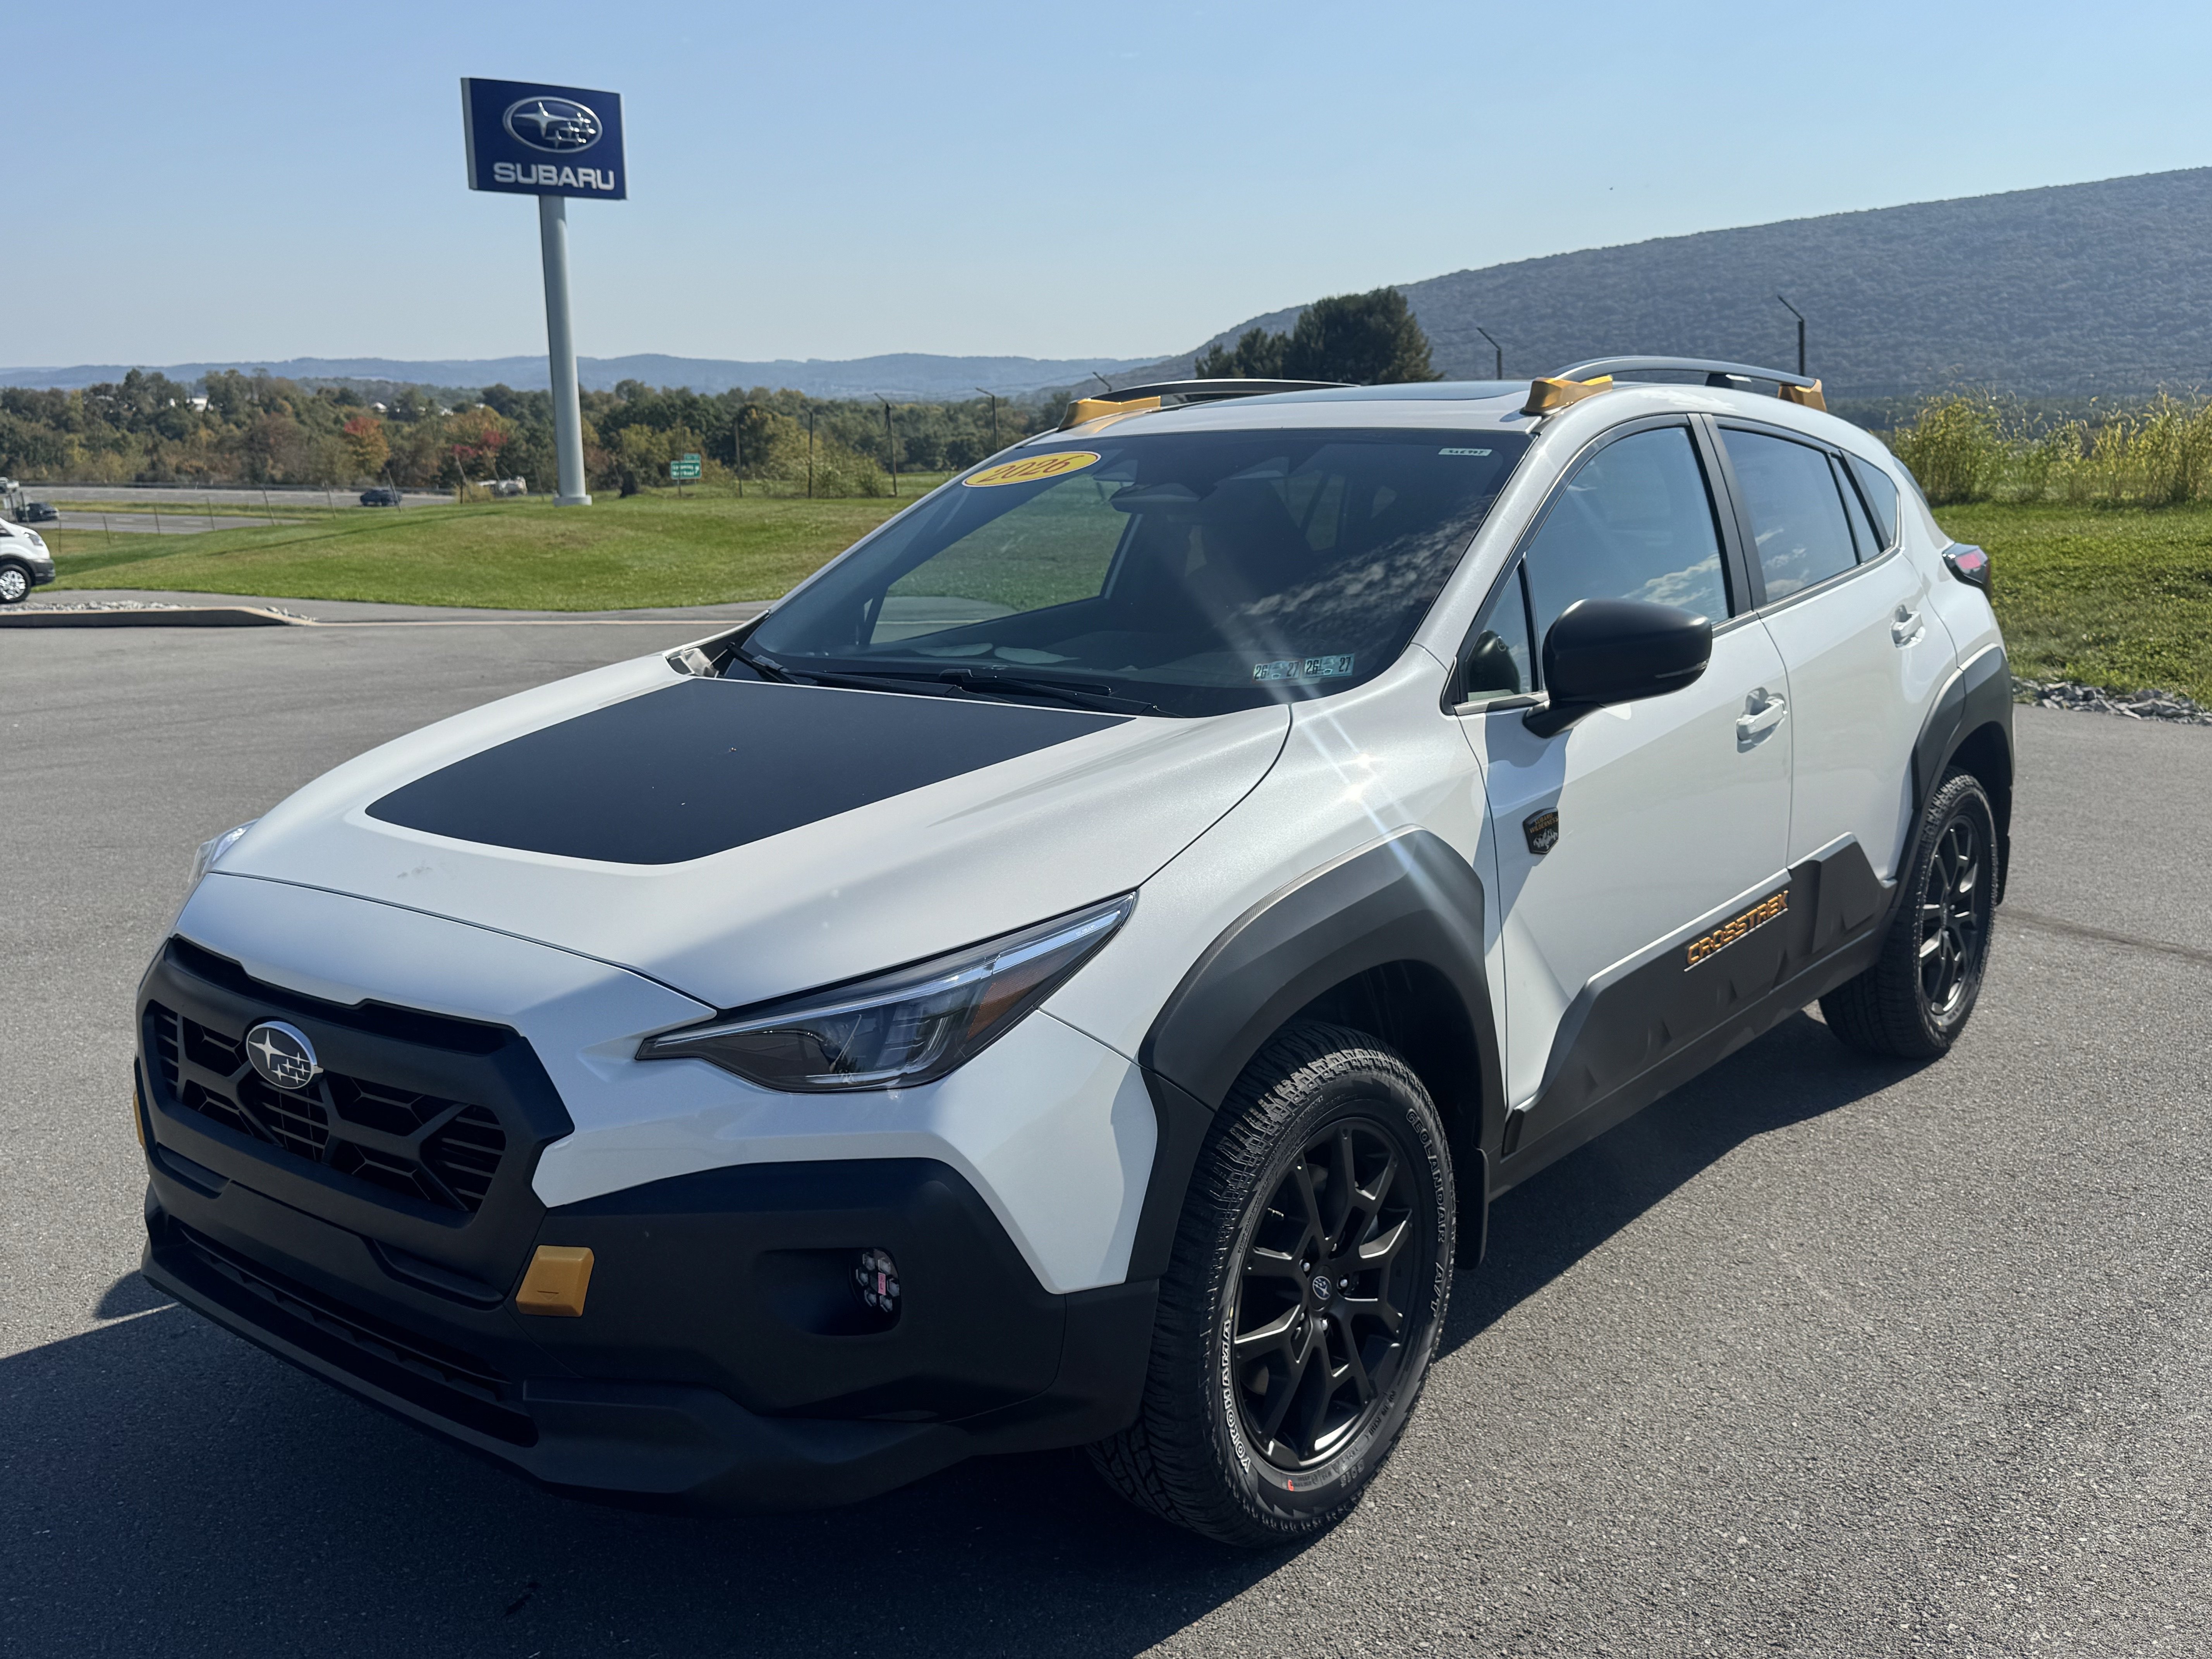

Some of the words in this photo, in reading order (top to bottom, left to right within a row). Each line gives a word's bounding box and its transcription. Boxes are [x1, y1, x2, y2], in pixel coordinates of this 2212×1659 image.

[493, 161, 615, 190] SUBARU
[976, 455, 1085, 483] 2026
[1254, 664, 1268, 679] 26
[1286, 661, 1300, 677] 27
[1306, 659, 1319, 674] 26
[1339, 656, 1351, 672] 27
[1687, 890, 1789, 965] CROSSTREK
[1406, 1108, 1446, 1243] GEOLANDAR
[1431, 1261, 1444, 1317] A/T
[1222, 1319, 1251, 1474] YOKOHAMA
